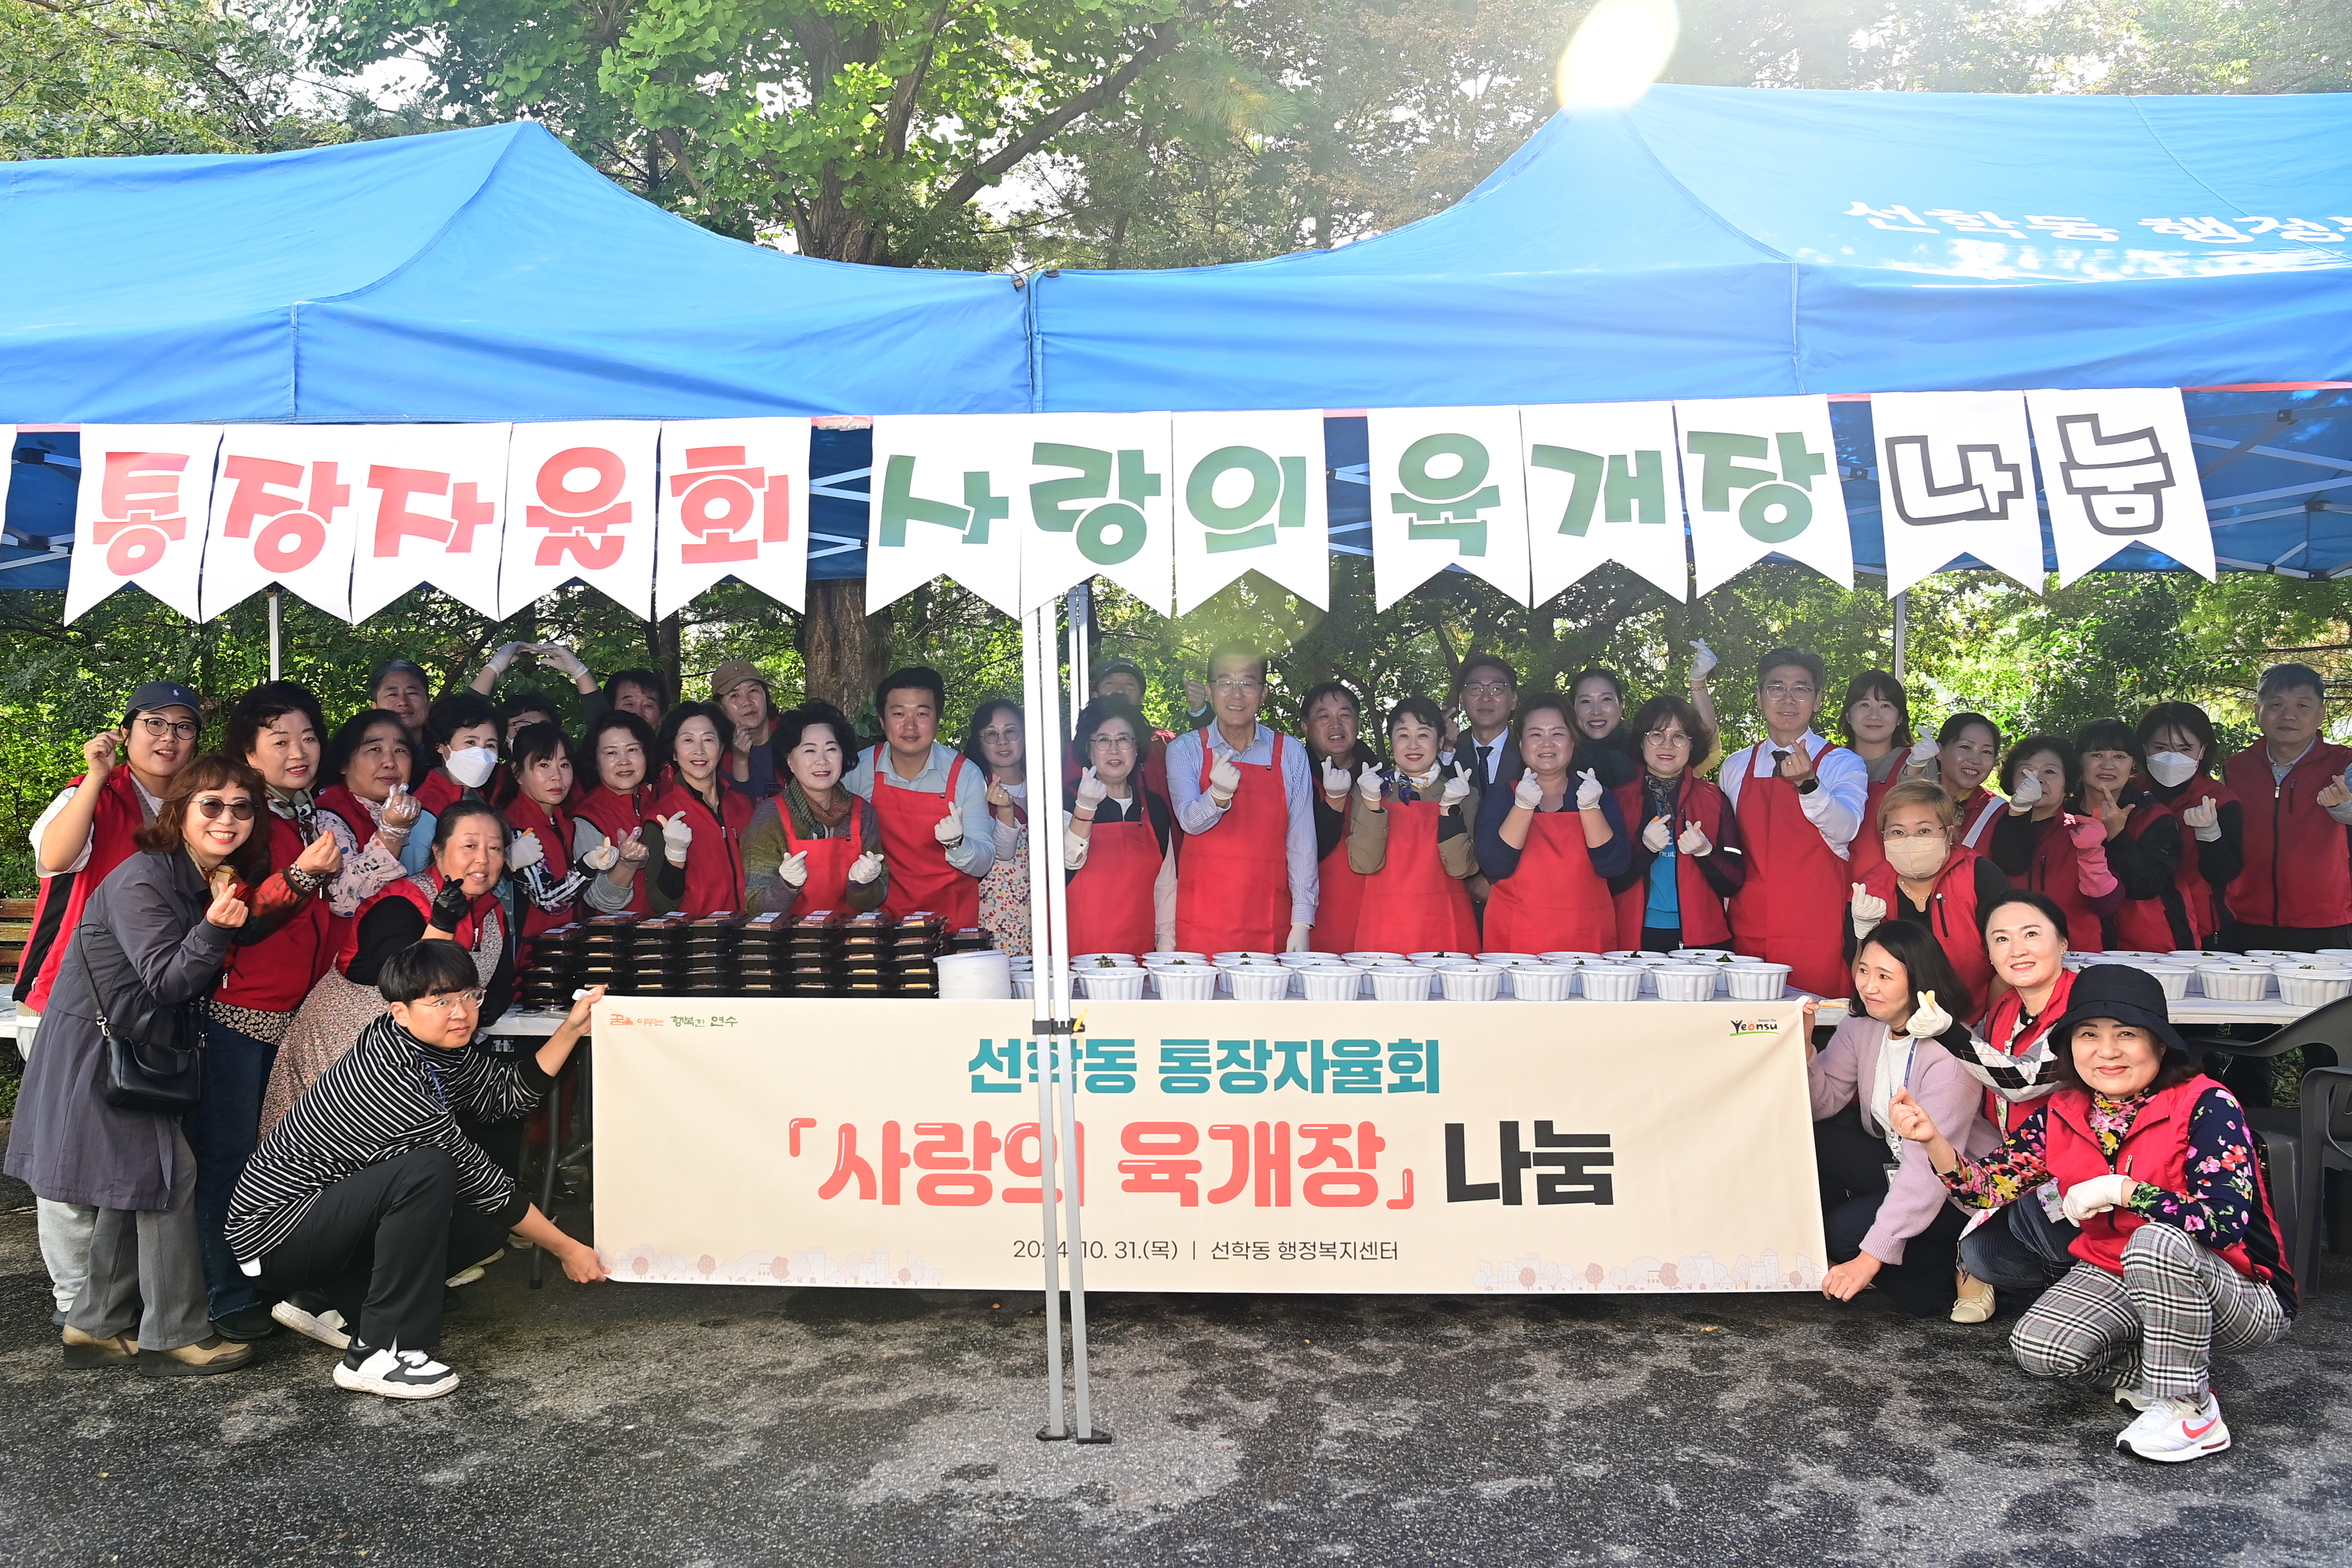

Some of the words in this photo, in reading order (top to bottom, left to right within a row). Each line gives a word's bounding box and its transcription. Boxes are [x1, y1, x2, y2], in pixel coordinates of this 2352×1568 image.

[1842, 201, 2120, 242] 선학동
[2137, 215, 2352, 244] 행정
[879, 442, 1307, 566] 사랑의
[1391, 431, 1827, 557] 육개장
[1885, 412, 2176, 536] 나눔
[670, 1015, 705, 1028] 행복한
[710, 1016, 739, 1028] 연수
[1730, 1019, 1778, 1034] Yeonsu
[1158, 1038, 1440, 1094] 통장자율회
[1116, 1120, 1415, 1210] 육개장」
[1444, 1120, 1615, 1206] 나눔
[1210, 1240, 1271, 1261] 선학동
[1277, 1240, 1398, 1261] 행정복지센터
